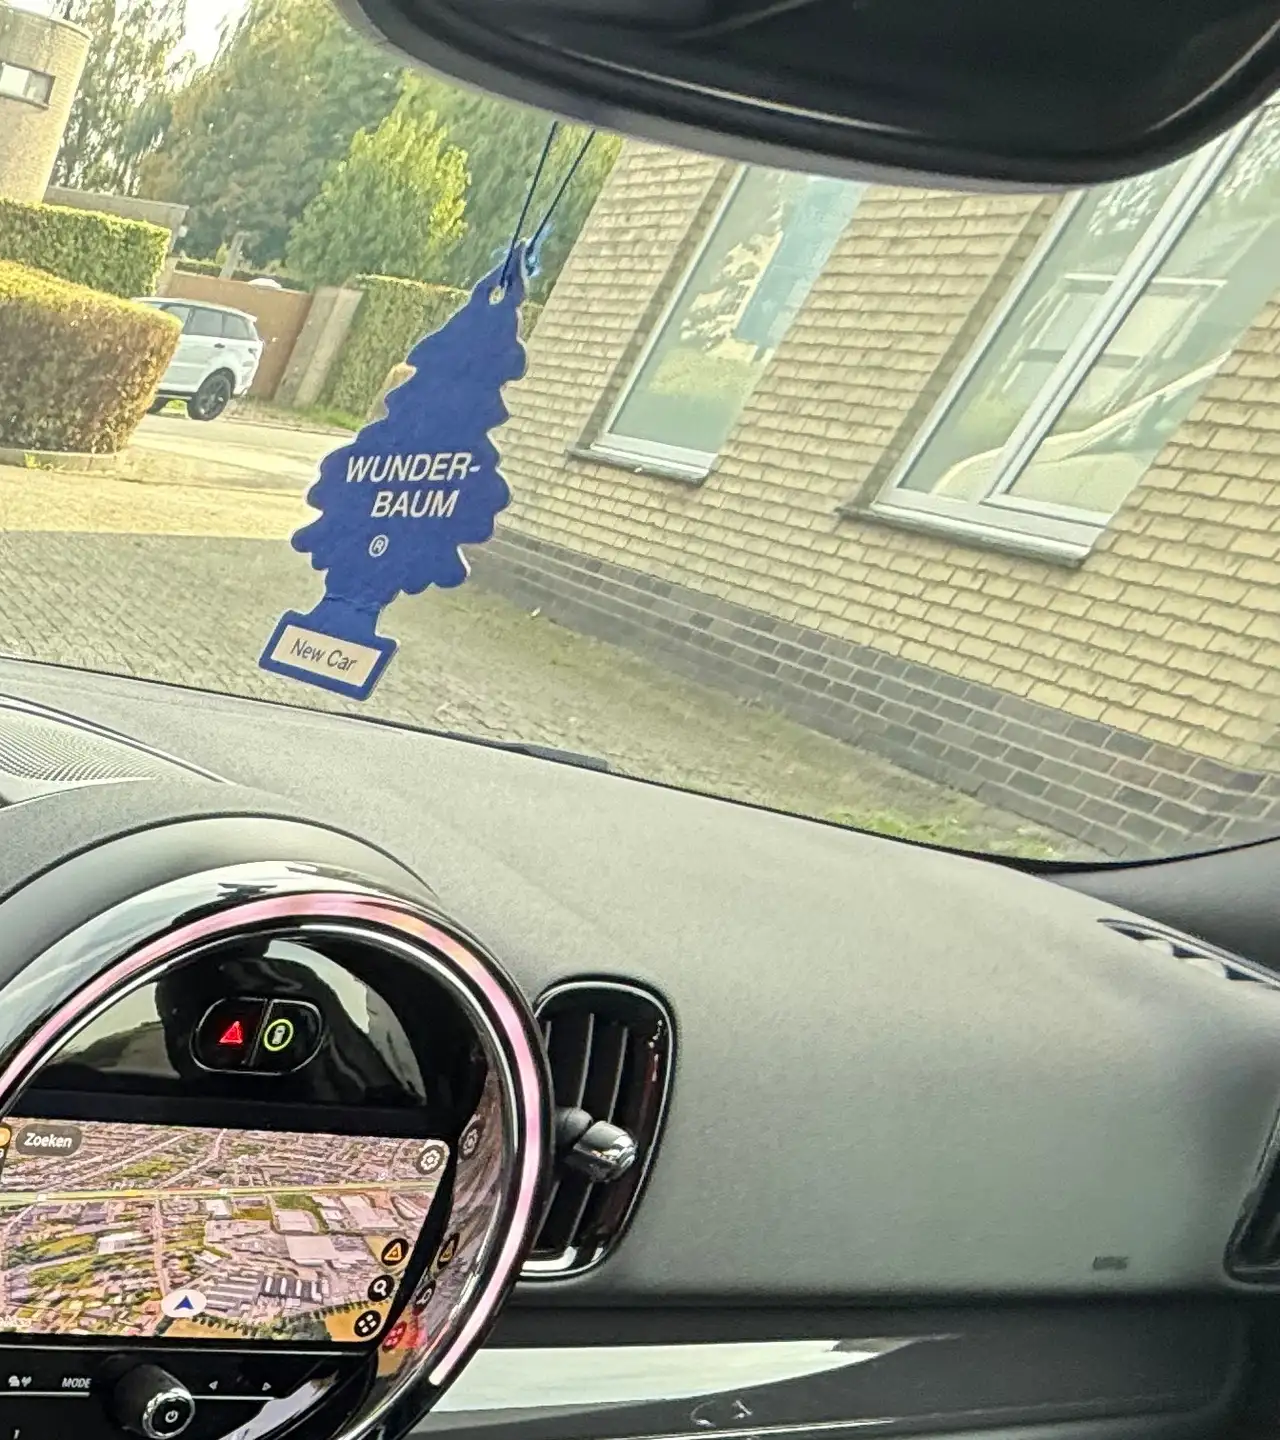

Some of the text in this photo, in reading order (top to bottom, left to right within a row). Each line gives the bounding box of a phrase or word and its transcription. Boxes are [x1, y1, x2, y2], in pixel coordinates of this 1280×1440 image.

[346, 452, 482, 483] WUNDER-
[370, 488, 460, 518] BAUM
[290, 638, 358, 671] New Car
[24, 1132, 73, 1149] Zoeken
[61, 1377, 92, 1389] MODE
